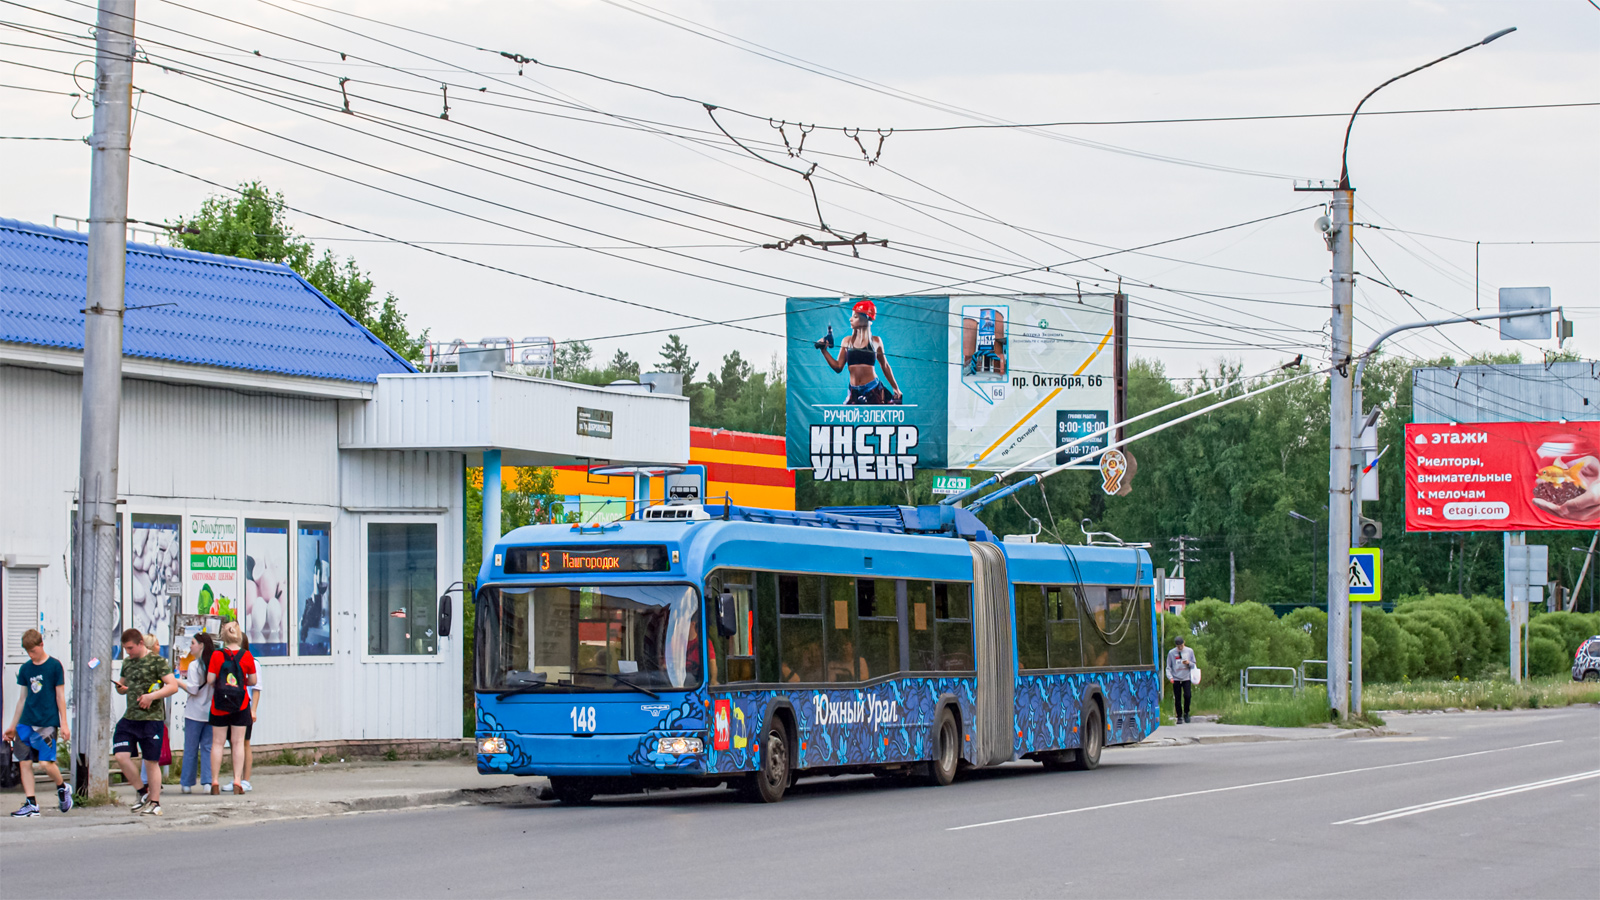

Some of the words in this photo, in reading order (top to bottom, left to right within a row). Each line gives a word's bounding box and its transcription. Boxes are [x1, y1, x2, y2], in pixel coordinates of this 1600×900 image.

[1012, 376, 1029, 389] пр.
[1032, 374, 1084, 389] Октября,
[1087, 374, 1103, 387] 66
[993, 389, 1003, 397] 66
[823, 408, 905, 423] РУЧНОЙ-ЭЛЕКТРО
[810, 425, 919, 455] ИНСТР
[1431, 432, 1488, 444] этажи
[810, 454, 918, 481] УМЕНТ
[1417, 456, 1484, 469] Риелторы,
[1417, 473, 1512, 483] внимательные
[1417, 490, 1425, 499] к
[1428, 490, 1486, 499] мелочам
[1417, 506, 1433, 515] на
[1448, 505, 1504, 517] etagi.com
[205, 541, 236, 554] ФРУКТЫ
[207, 556, 236, 570] ОВОЩИ
[541, 552, 550, 570] 3
[562, 552, 620, 570] Машгородок
[570, 706, 597, 732] 148
[813, 692, 865, 725] Южный
[867, 693, 898, 732] Урал
